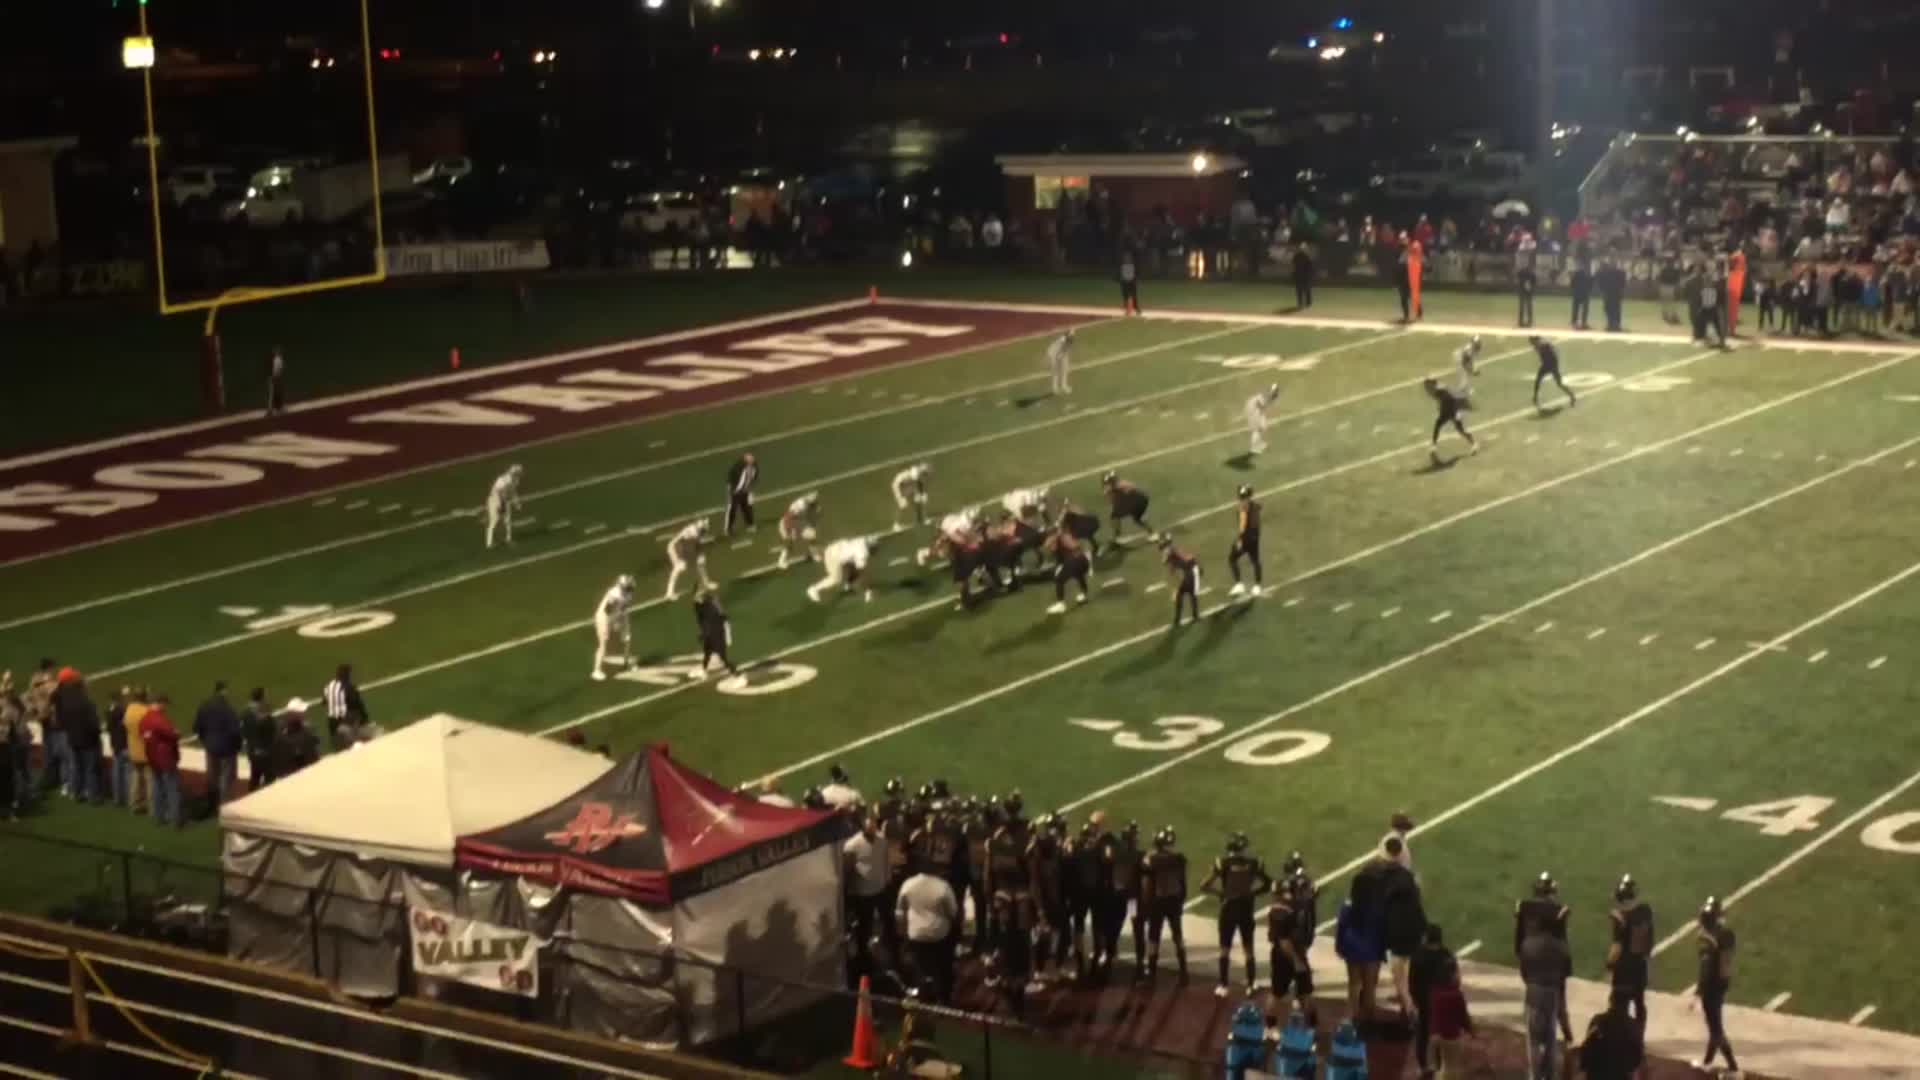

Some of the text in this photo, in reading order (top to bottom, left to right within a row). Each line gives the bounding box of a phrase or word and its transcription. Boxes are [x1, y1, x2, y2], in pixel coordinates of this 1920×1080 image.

[0, 316, 975, 531] SON VALLEY
[1112, 715, 1332, 765] 30
[417, 936, 530, 966] VALLEY
